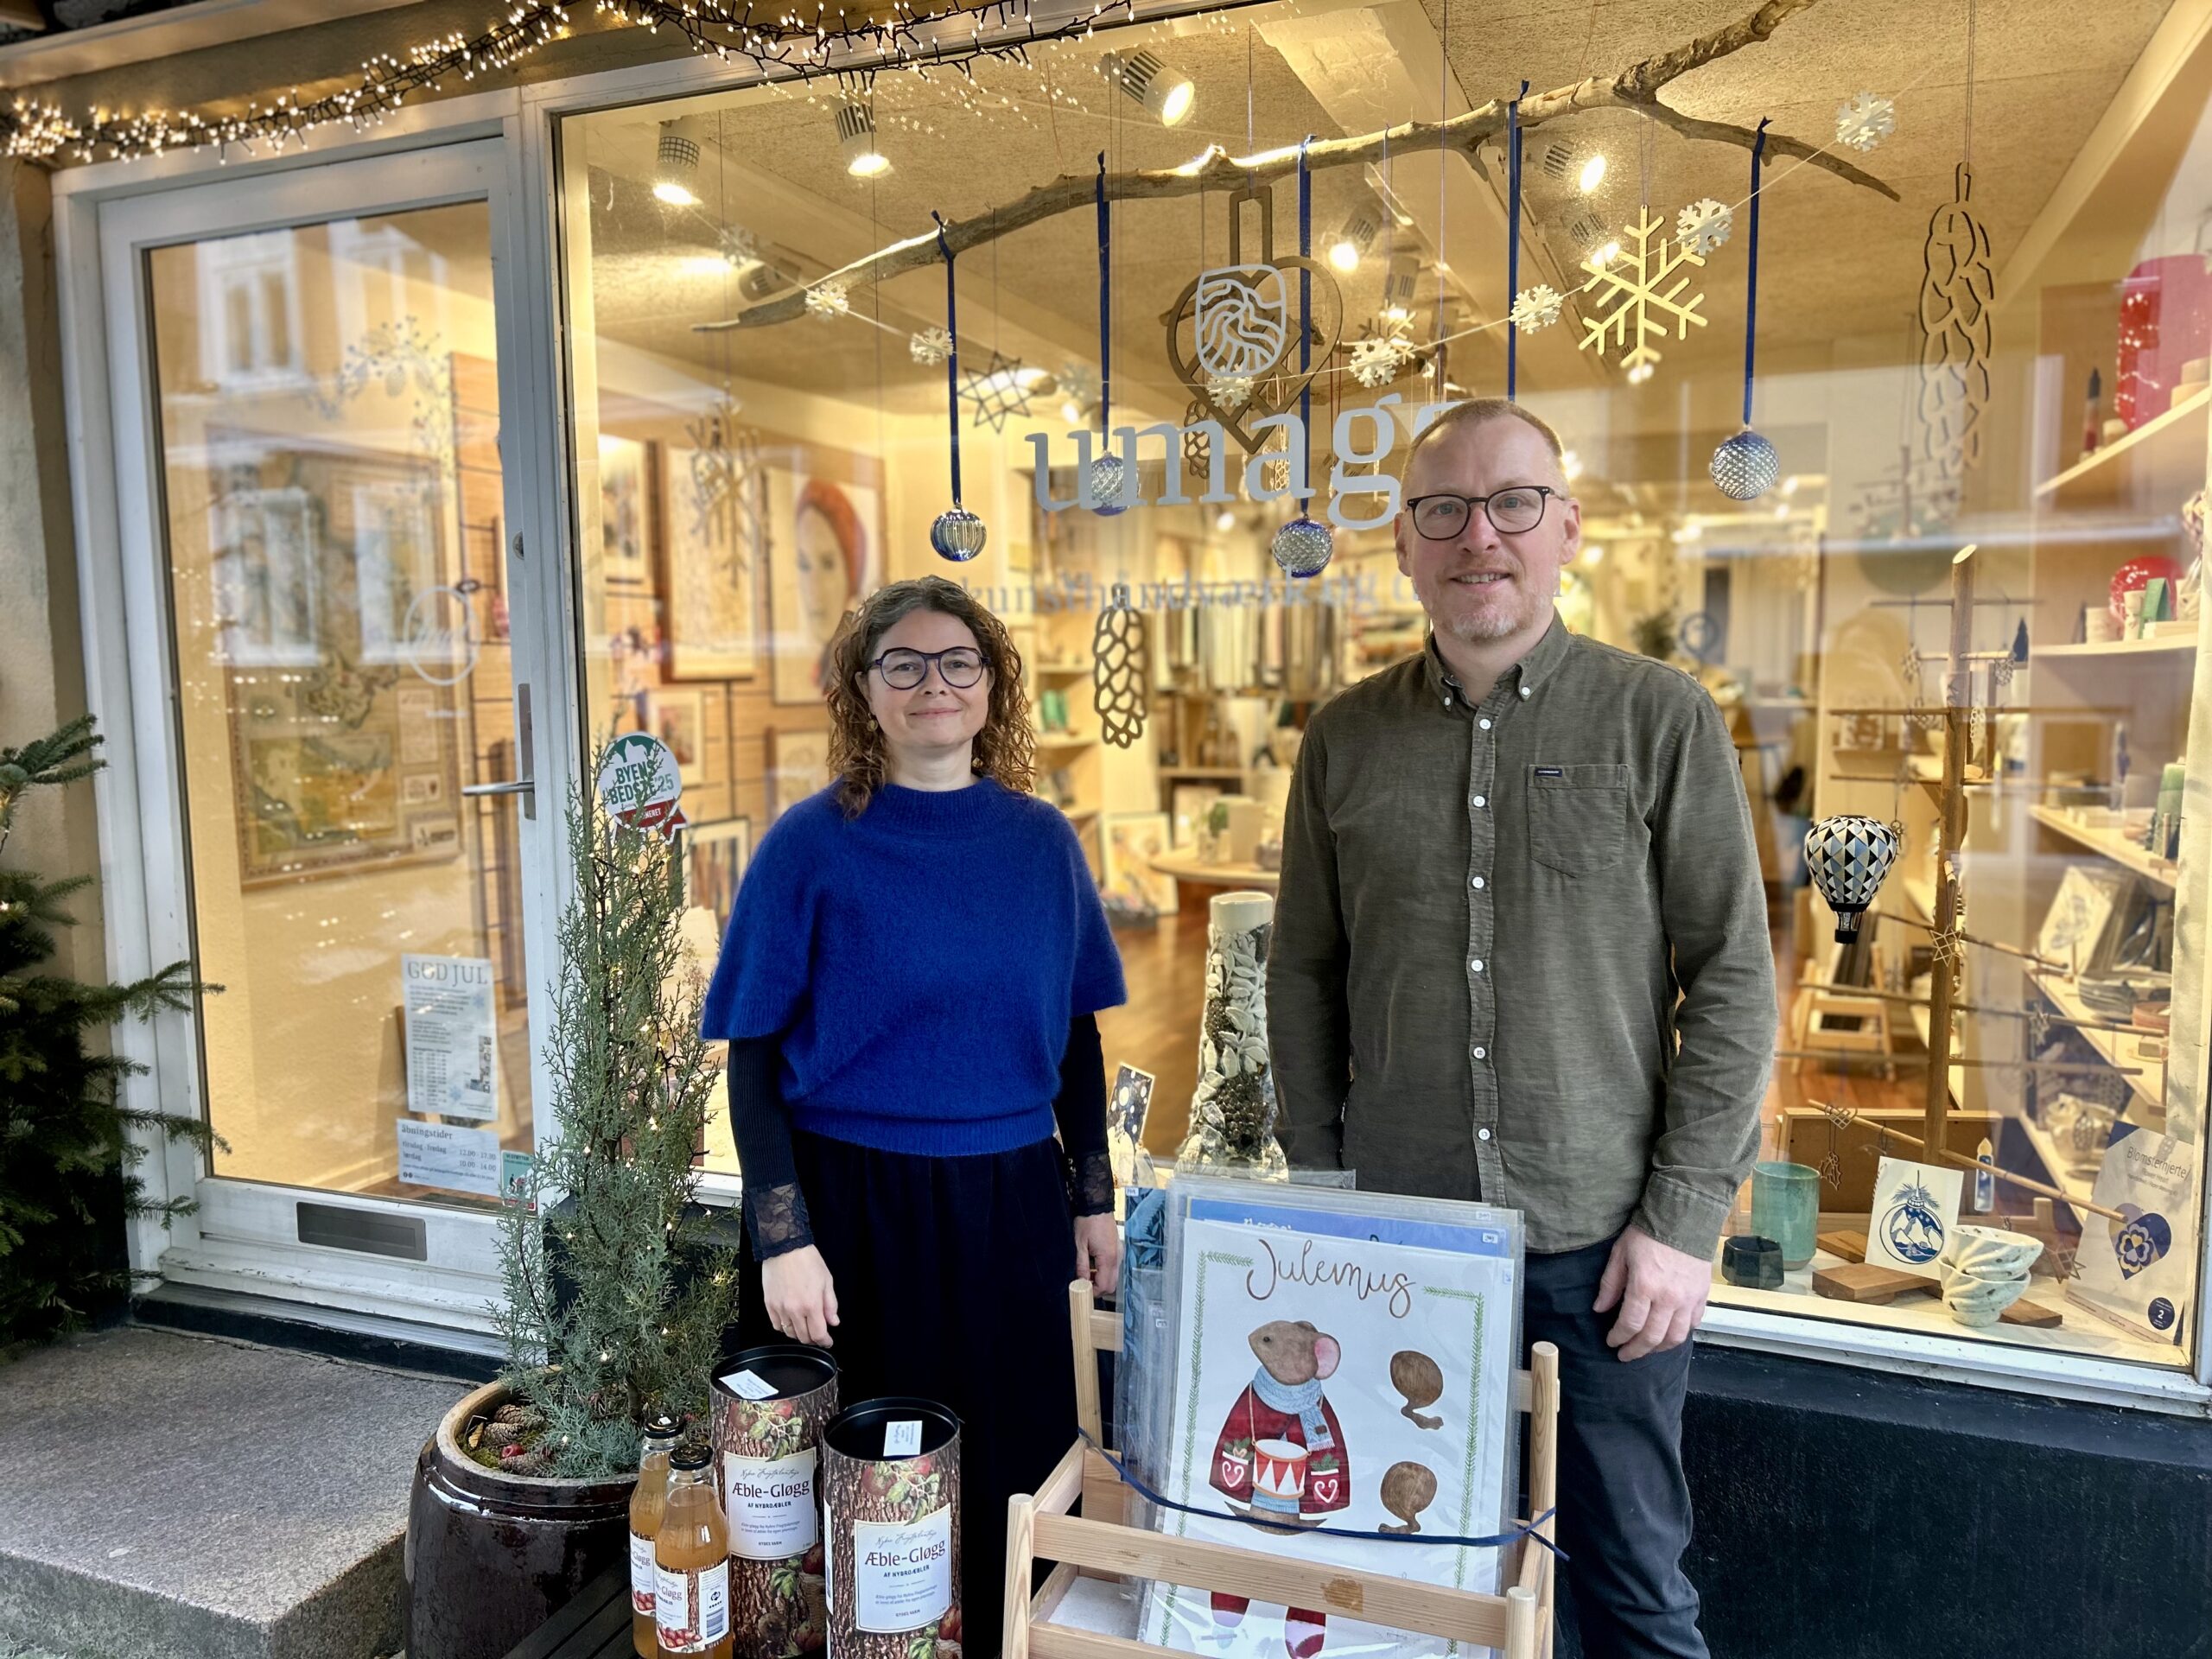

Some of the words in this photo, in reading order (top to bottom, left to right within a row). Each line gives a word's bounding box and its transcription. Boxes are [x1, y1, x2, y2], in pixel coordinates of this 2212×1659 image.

[1024, 393, 1464, 531] umag
[615, 760, 655, 785] BYENS
[407, 961, 448, 982] GOD
[452, 964, 488, 988] JUL
[401, 1124, 453, 1141] åbningstider
[1246, 1239, 1416, 1319] Julemus
[2158, 1309, 2164, 1319] 2
[732, 1480, 810, 1498] Æble-Gløgg
[864, 1540, 945, 1567] Æble-Gløgg
